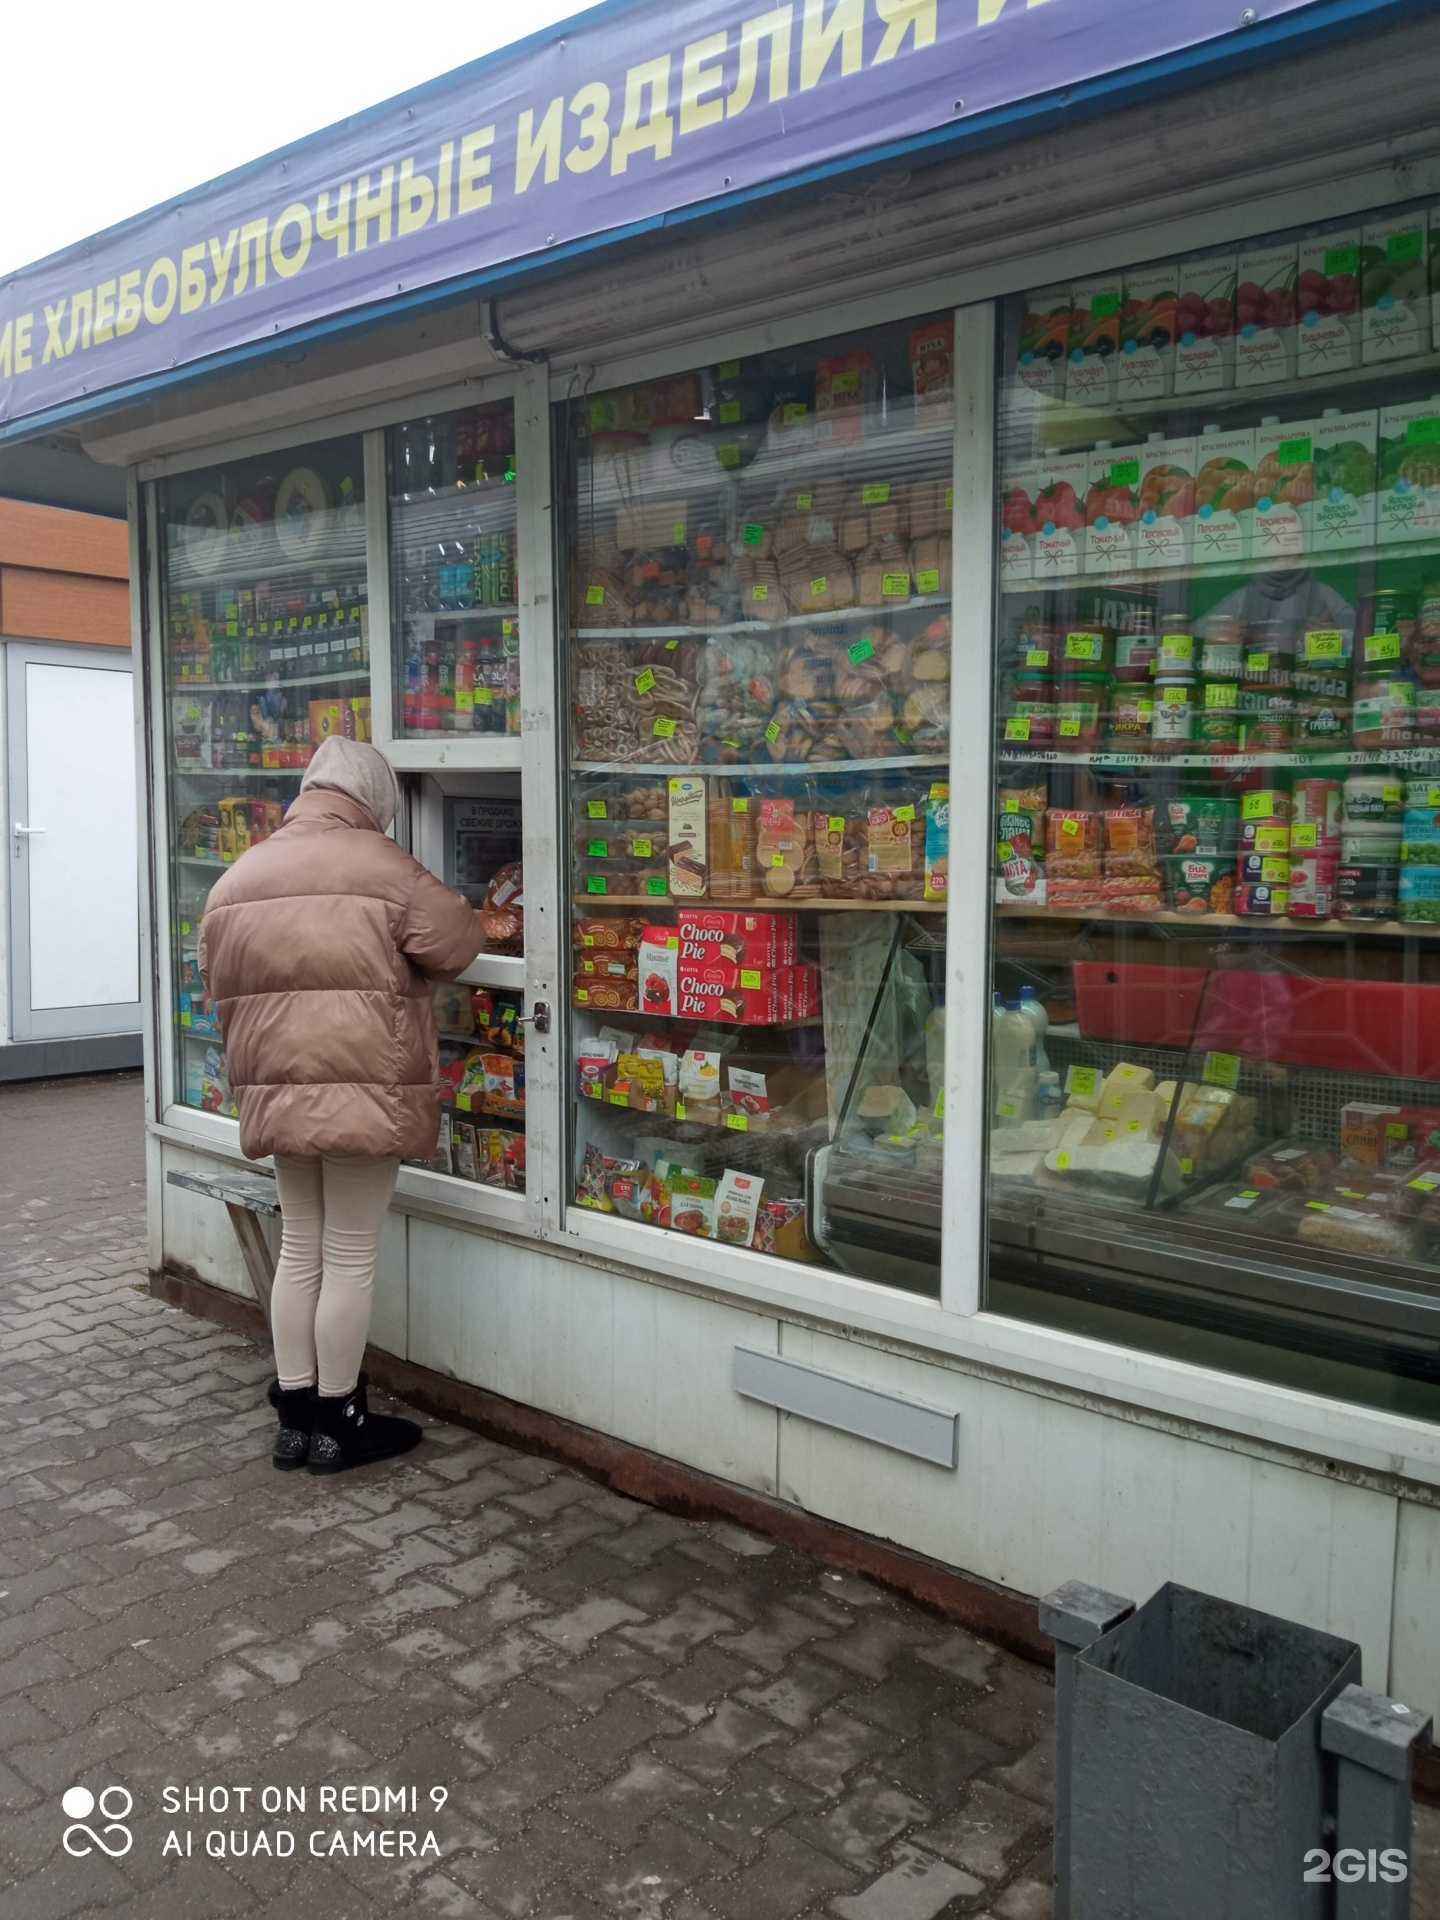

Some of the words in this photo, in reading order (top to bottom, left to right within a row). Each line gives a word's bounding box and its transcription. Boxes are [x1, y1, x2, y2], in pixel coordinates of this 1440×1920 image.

[42, 125, 497, 365] ХЛЕБОБУЛОЧНЫЕ
[680, 923, 725, 942] Choco
[680, 942, 706, 960] Pie
[680, 977, 725, 996] Choco
[681, 996, 706, 1014] Pie
